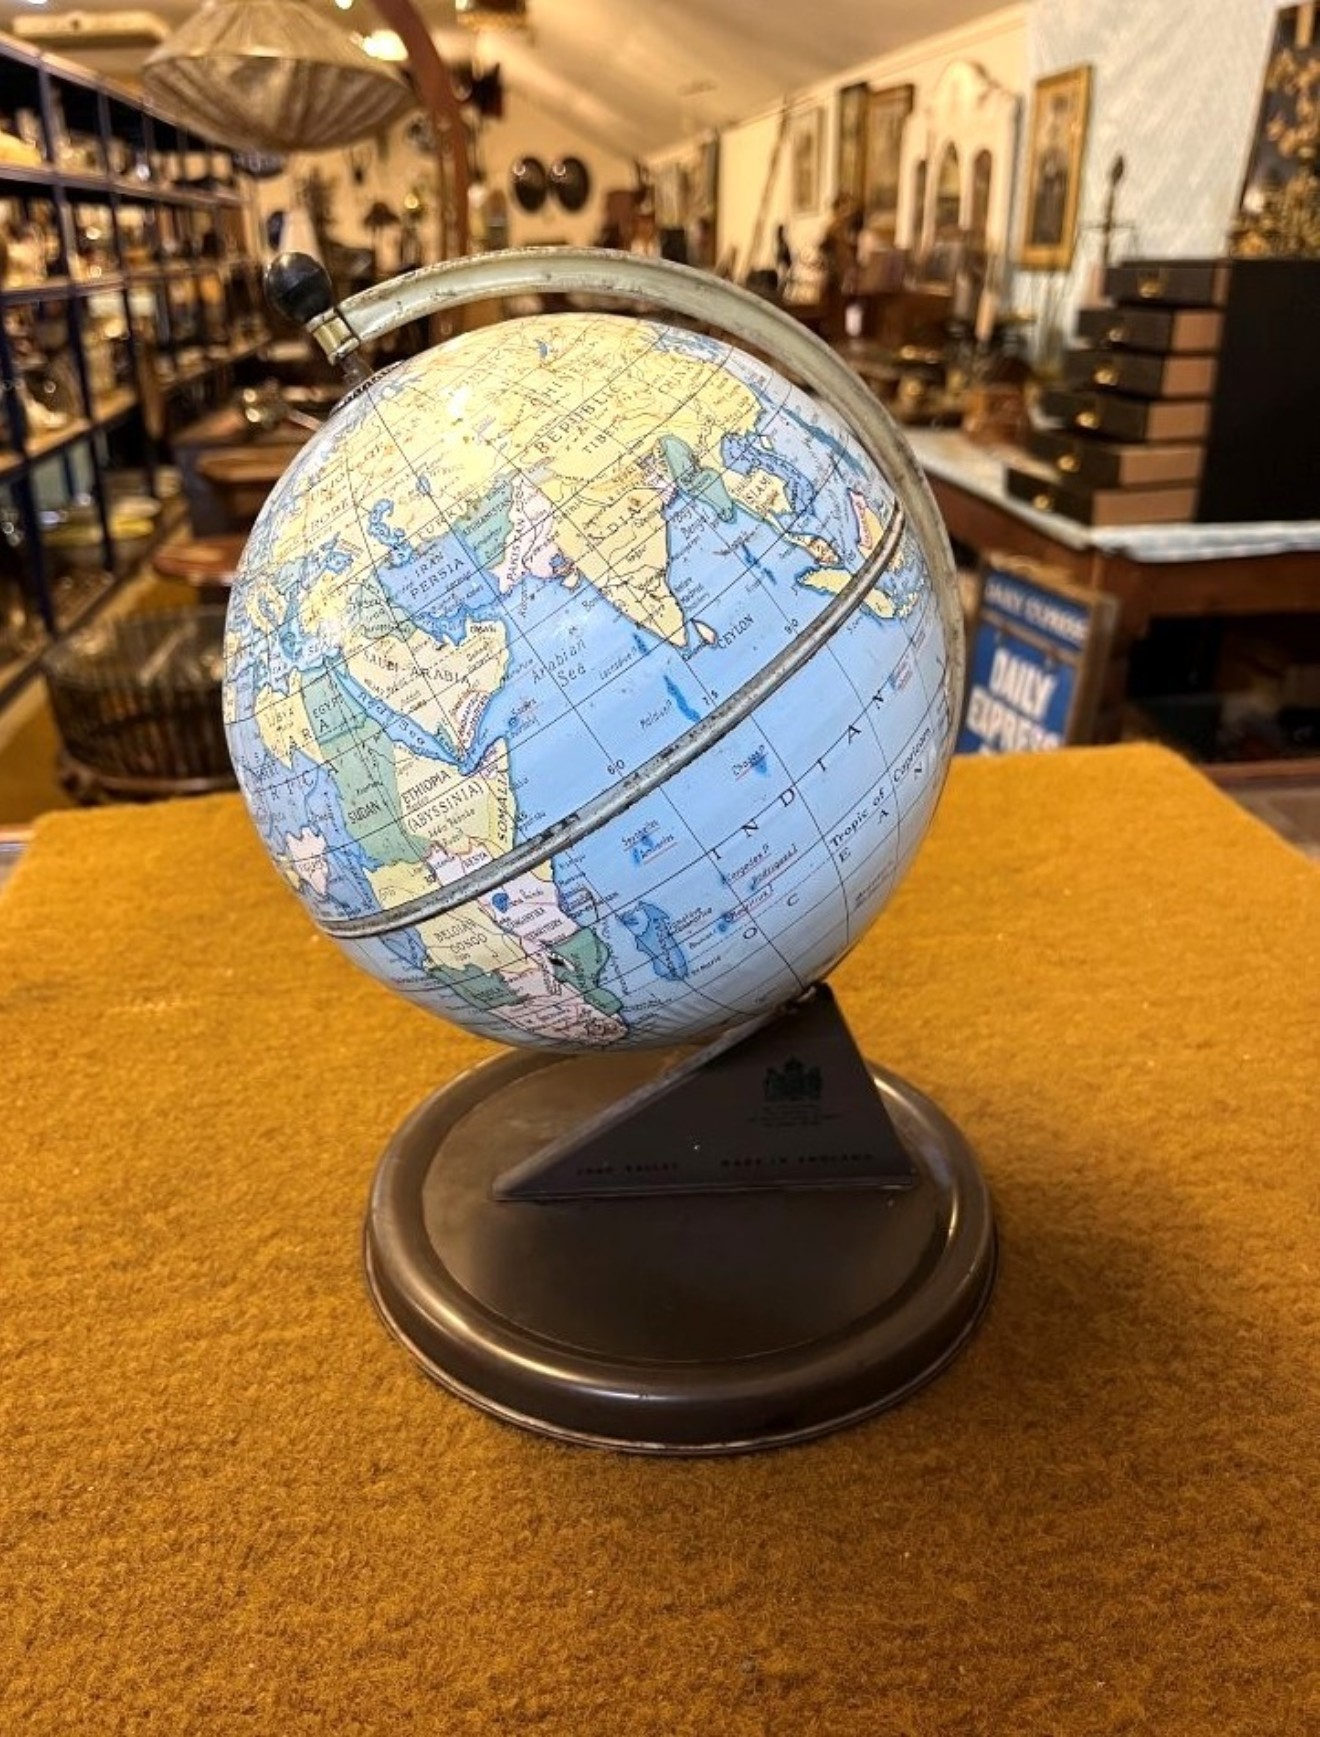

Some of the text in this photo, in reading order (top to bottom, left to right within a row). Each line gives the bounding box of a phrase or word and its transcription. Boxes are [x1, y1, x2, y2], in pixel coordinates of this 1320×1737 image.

[534, 383, 620, 454] REPUBLIC
[410, 557, 465, 599] PERSIA
[414, 550, 445, 578] IRAN
[717, 614, 754, 650] CEYLON
[532, 638, 586, 685] Arabian
[557, 662, 587, 688] Sea
[988, 647, 1058, 720] DAILY
[400, 769, 452, 805] ETHIOPIA
[828, 810, 869, 849] Tropic
[871, 786, 886, 807] of
[891, 727, 932, 784] Capricorn
[347, 799, 381, 821] SUDAN
[406, 779, 485, 834] (ABYSSINIA)
[433, 918, 477, 943] BELGIAN
[449, 932, 488, 954] CONGO
